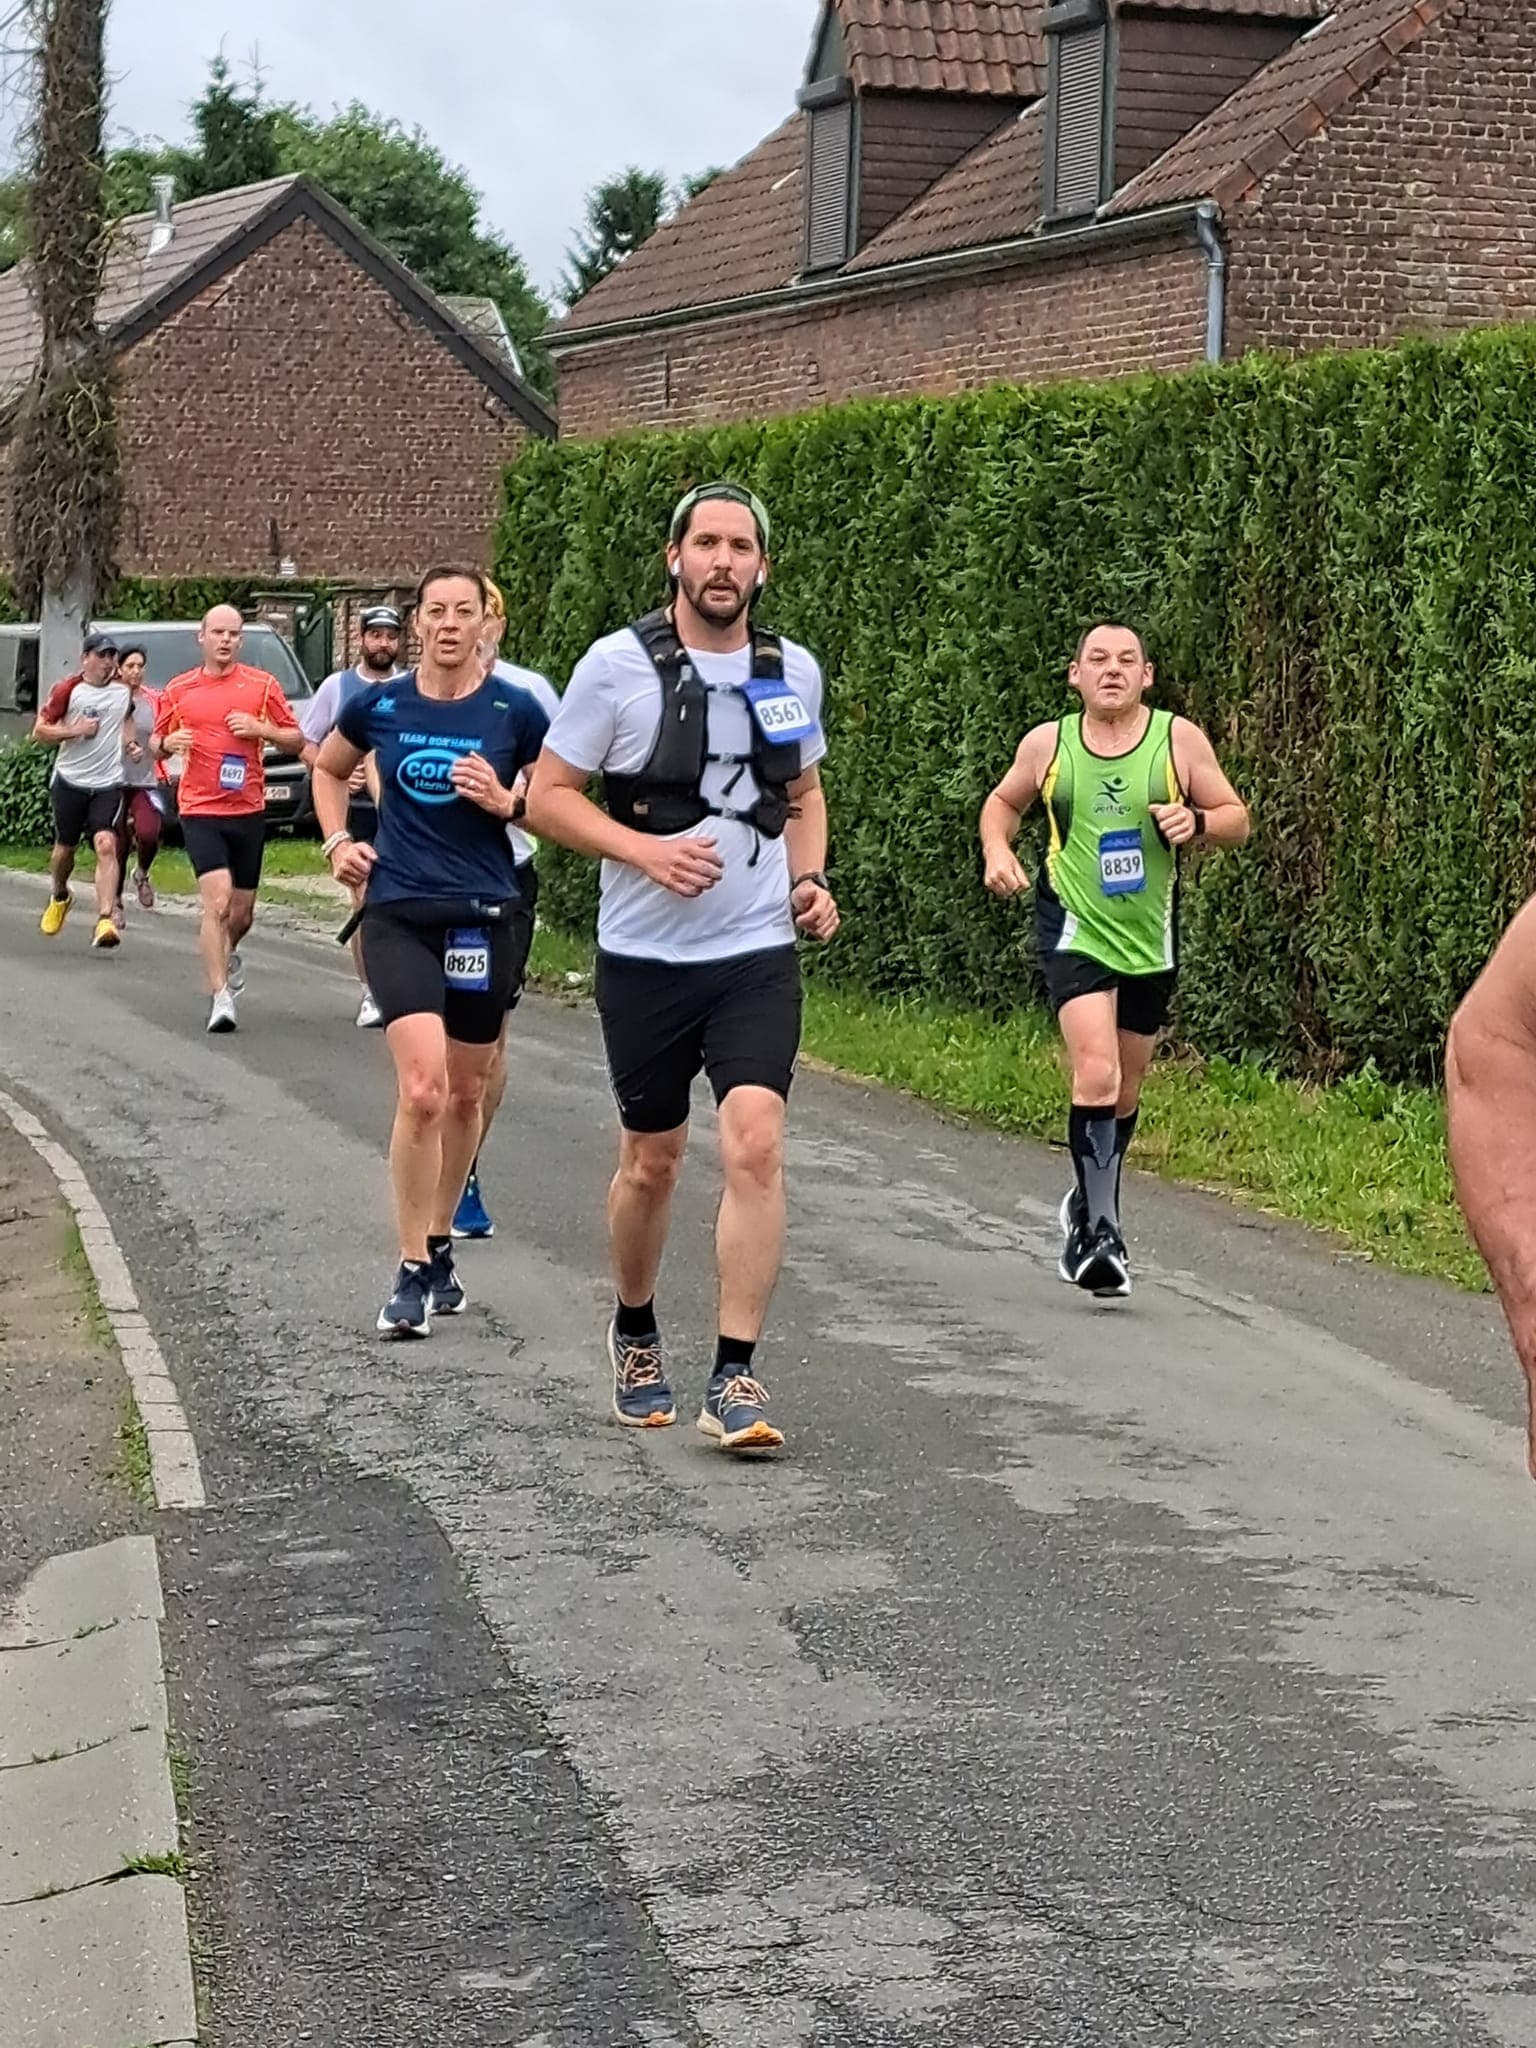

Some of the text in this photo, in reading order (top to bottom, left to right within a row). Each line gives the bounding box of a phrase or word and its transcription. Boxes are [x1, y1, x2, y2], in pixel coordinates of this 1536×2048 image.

[759, 701, 804, 726] 8567
[399, 732, 427, 746] TEAM
[405, 761, 454, 780] cor
[1103, 855, 1141, 876] 8839
[446, 953, 486, 973] 8825
